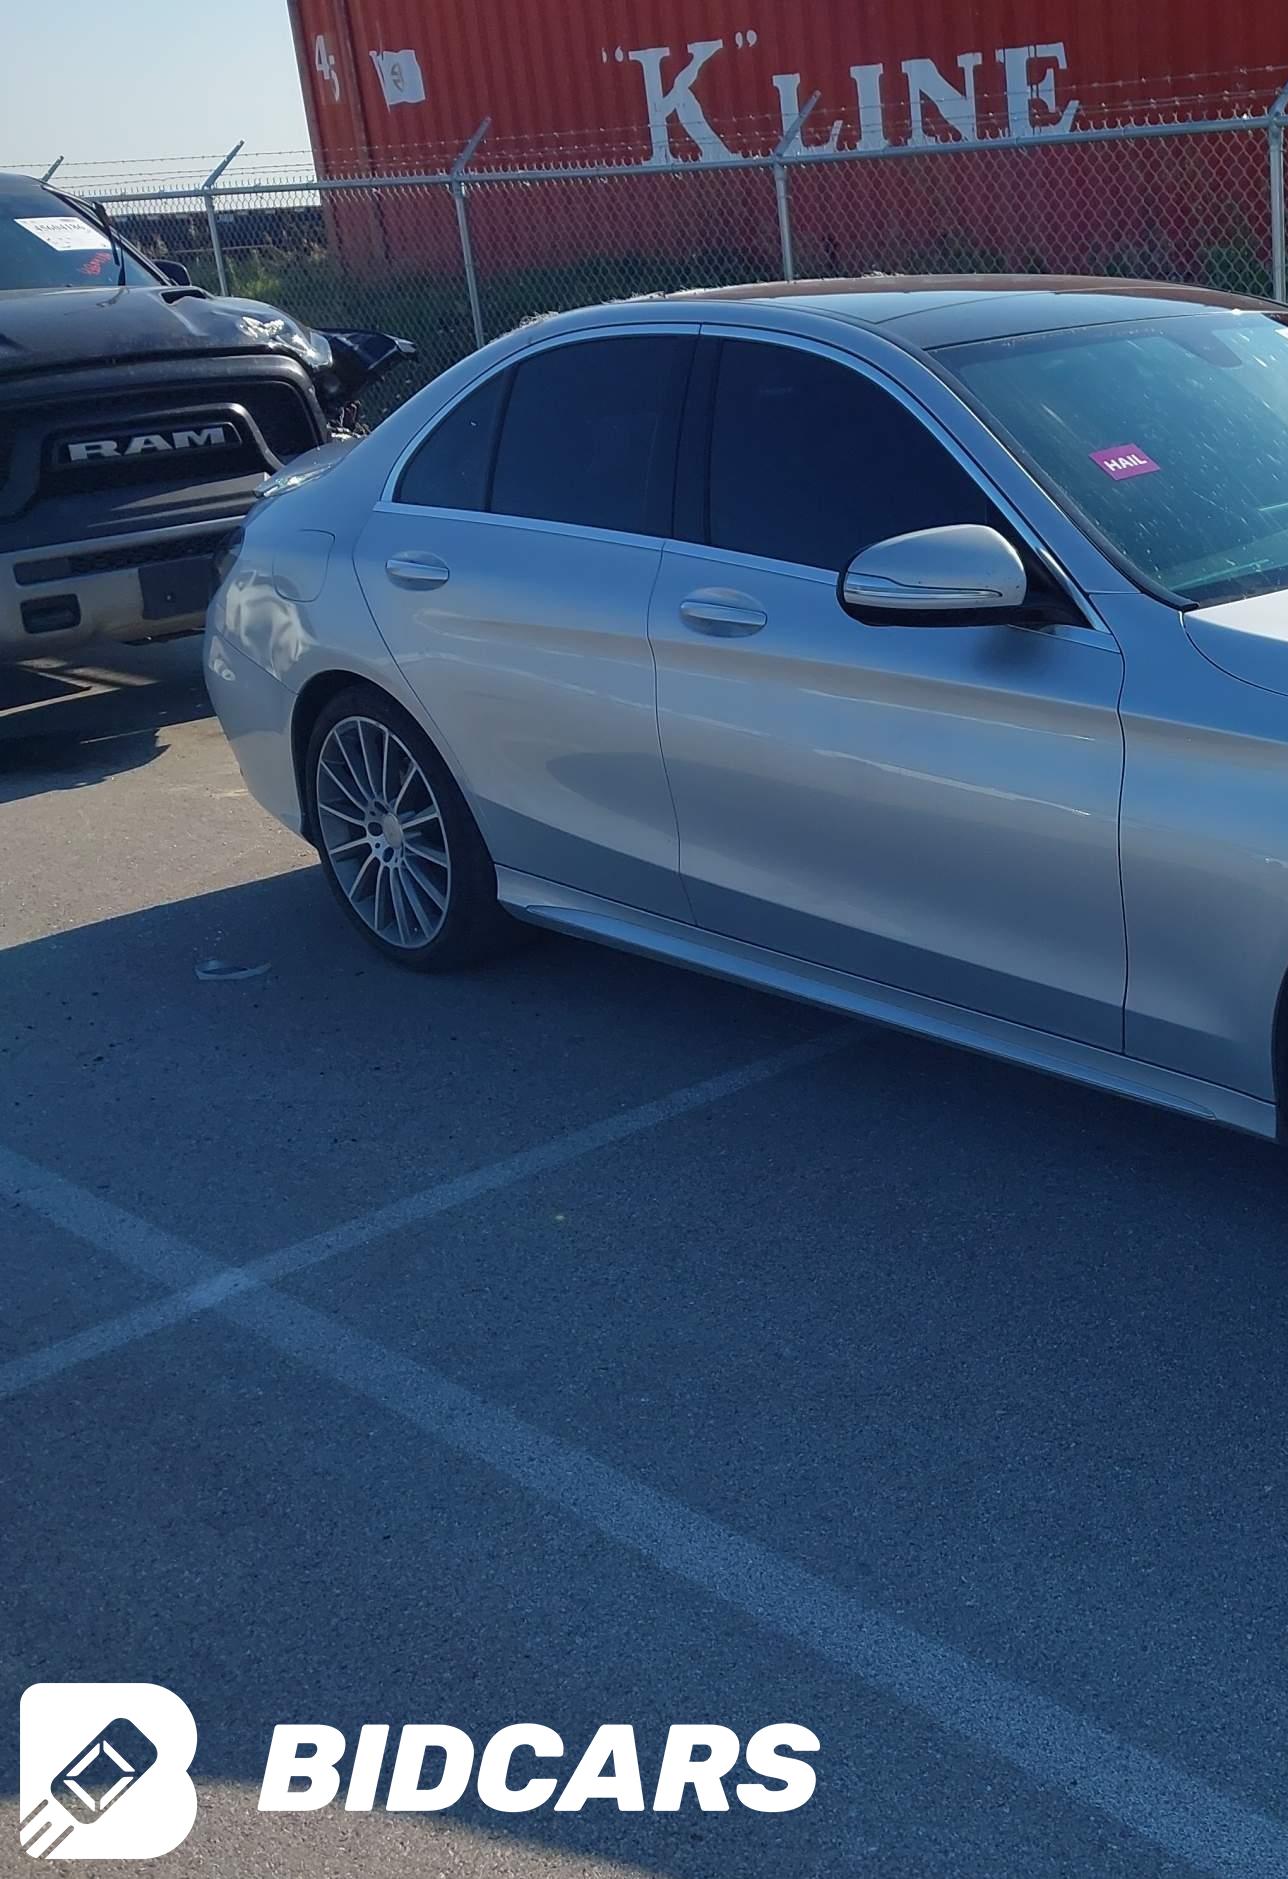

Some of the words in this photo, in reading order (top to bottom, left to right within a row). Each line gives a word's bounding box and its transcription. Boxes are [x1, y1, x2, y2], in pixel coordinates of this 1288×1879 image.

[772, 42, 1080, 157] LINE
[68, 427, 225, 461] RAM
[1103, 453, 1148, 472] HAIL
